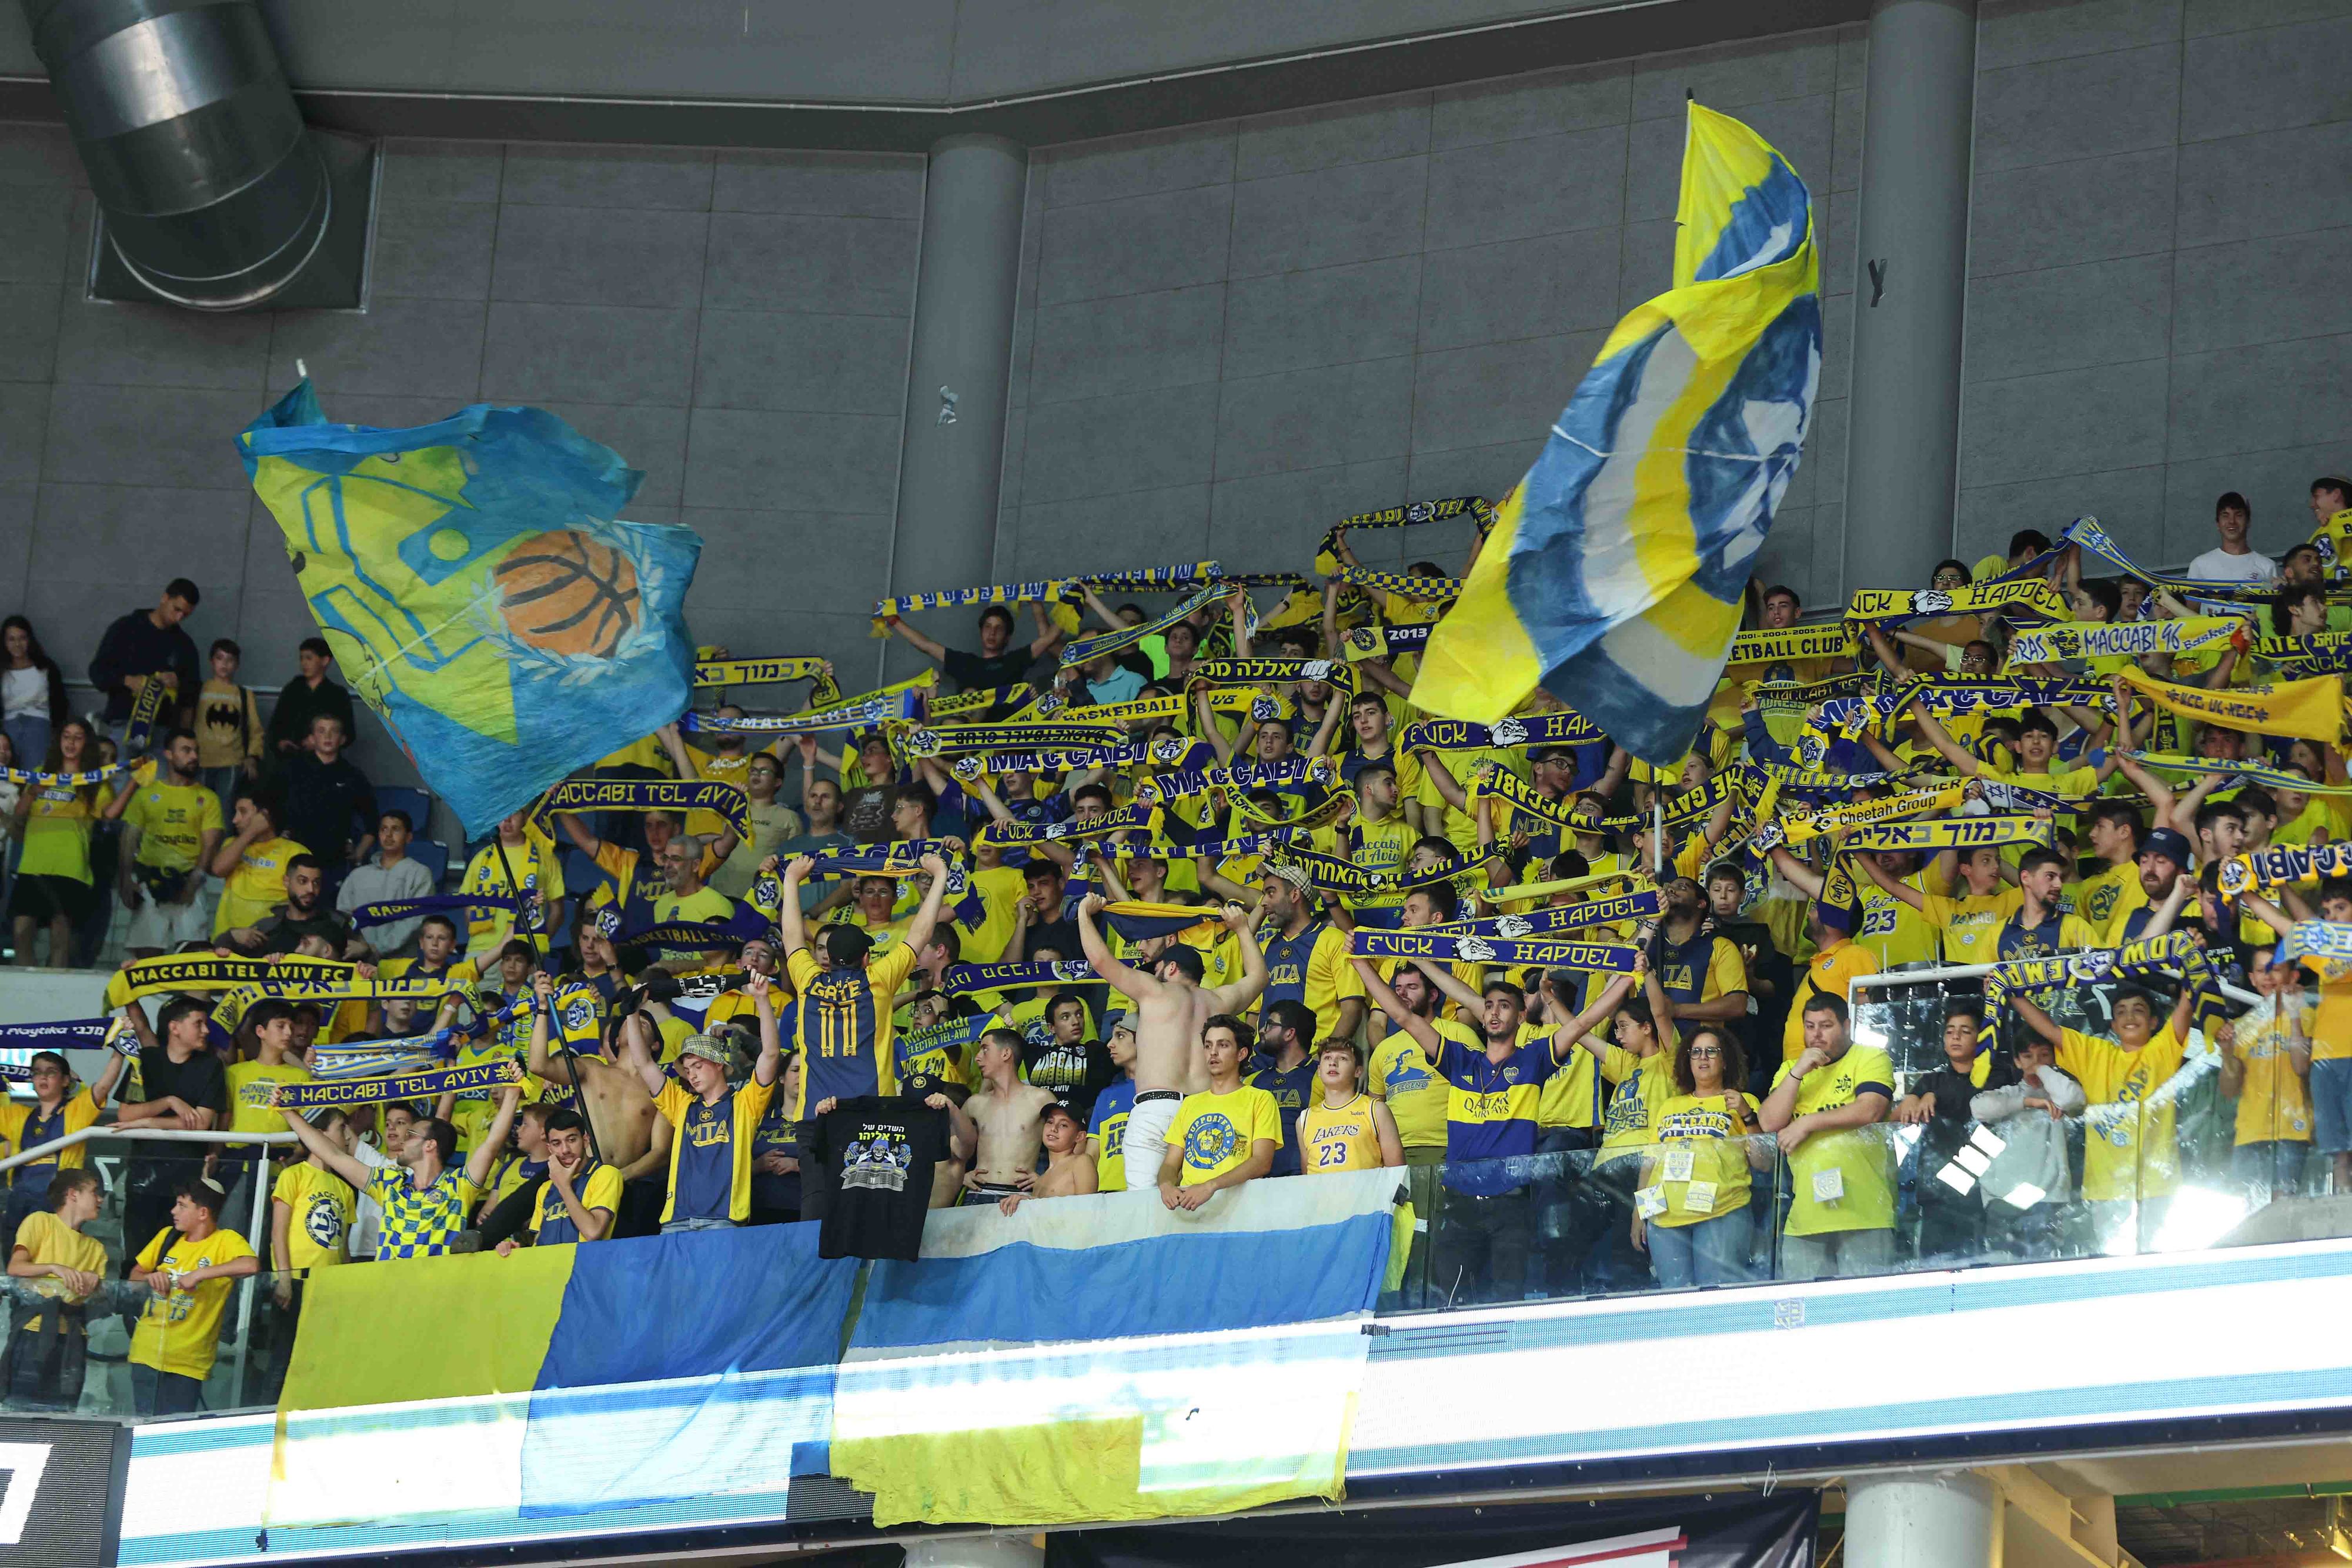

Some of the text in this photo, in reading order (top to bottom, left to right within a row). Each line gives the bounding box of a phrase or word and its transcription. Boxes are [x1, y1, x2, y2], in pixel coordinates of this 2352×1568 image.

[903, 583, 1043, 608] MACCABI
[1969, 583, 2057, 610] HAPOEL
[1388, 628, 1428, 640] 2013
[1802, 637, 1843, 654] CLUB
[2084, 624, 2157, 654] MACCABI
[734, 663, 794, 683] כמוך
[741, 707, 854, 730] MACCABI
[1063, 699, 1182, 722] BASKETBALL
[956, 731, 997, 743] CLUB
[989, 743, 1147, 774] MACCABI
[1157, 758, 1309, 798] MACCABI
[552, 784, 746, 813] ACCABI TEL AVIV
[1659, 785, 1708, 821] GAT
[1839, 795, 1936, 825] Cheetah Group
[1075, 807, 1135, 832] HAPOEL
[1846, 824, 1932, 847] באלים
[1942, 820, 2016, 846] כמוך
[1354, 849, 1401, 864] el Aviv
[1549, 899, 1645, 928] HAPOEL
[1863, 910, 1896, 935] 23
[1514, 943, 1618, 967] HAPOEL
[132, 965, 346, 983] MACCABI TEL AVIV FC
[1663, 964, 1692, 986] TA
[810, 979, 861, 1001] GATE
[74, 1026, 106, 1037] מכבי
[907, 1028, 971, 1055] ELECTRA TEL-AVIV
[300, 1082, 388, 1103] MACCABI
[396, 1077, 433, 1093] TEL
[443, 1068, 490, 1088] AVIV
[1271, 1089, 1301, 1104] TA
[686, 1119, 730, 1141] MTA
[863, 1123, 905, 1133] השדים של
[1188, 1116, 1233, 1139] SUPPORTERS
[1312, 1125, 1359, 1144] LAKERS
[1680, 1116, 1727, 1131] YEARS
[858, 1131, 906, 1142] יד אליהו
[1211, 1146, 1230, 1165] LIFE
[1320, 1142, 1346, 1166] 23
